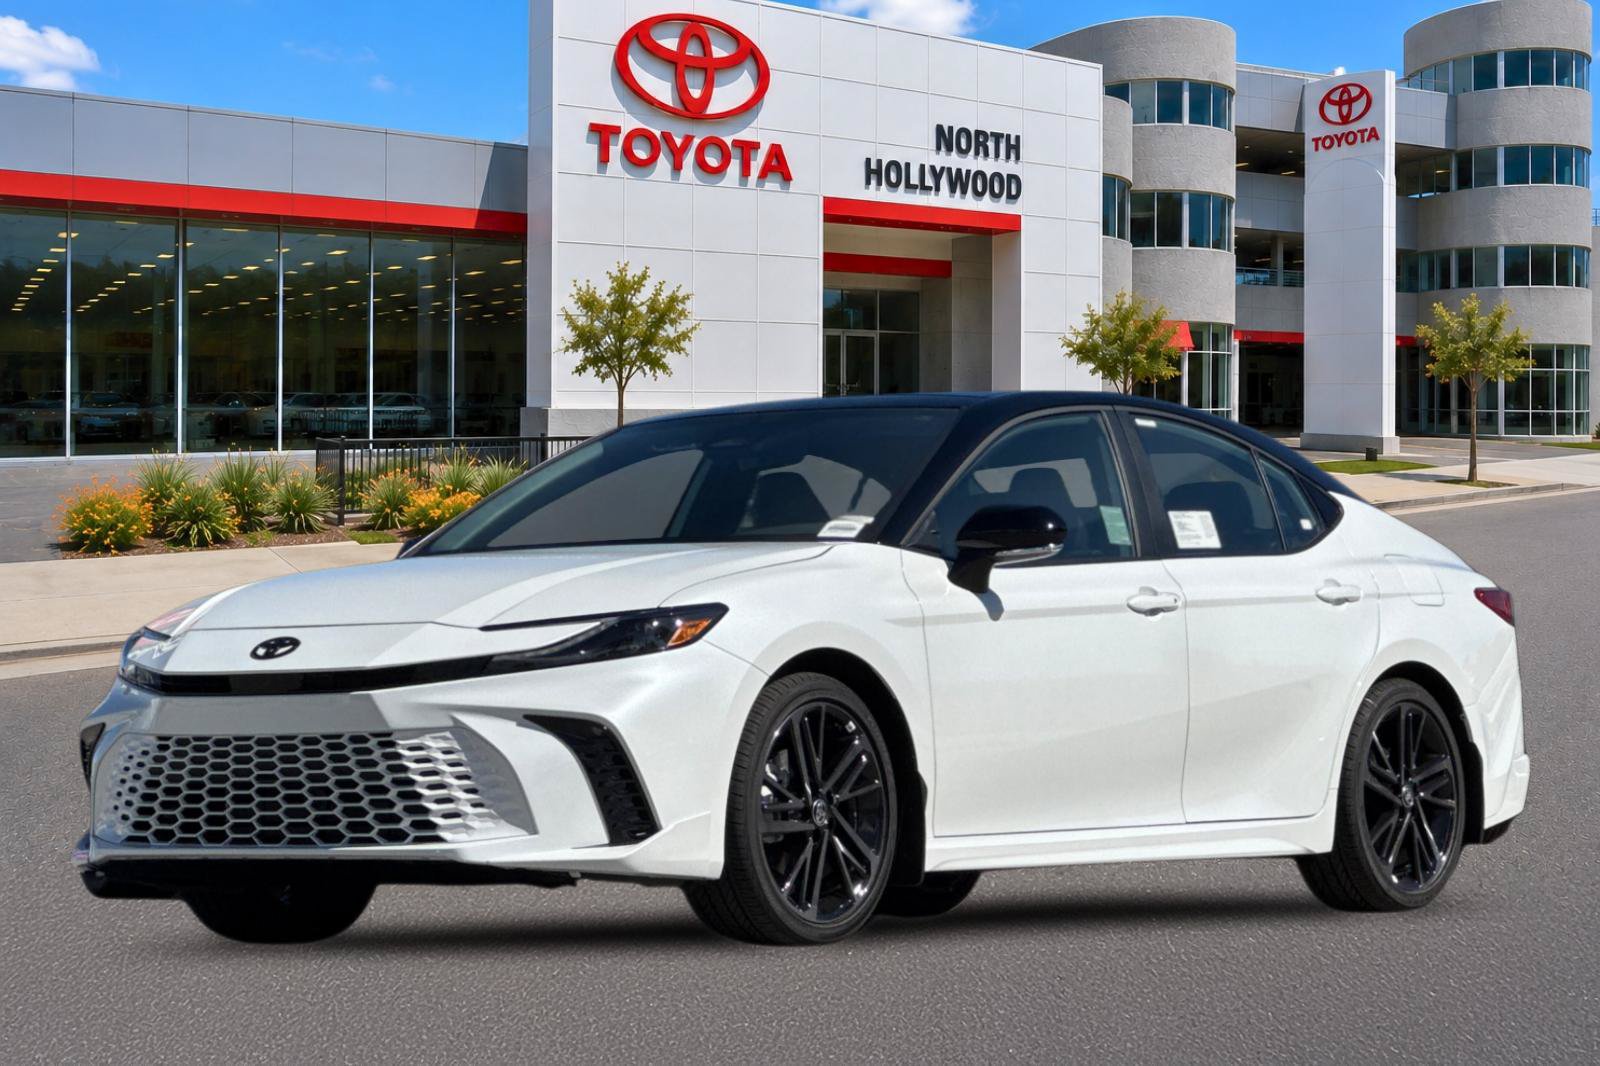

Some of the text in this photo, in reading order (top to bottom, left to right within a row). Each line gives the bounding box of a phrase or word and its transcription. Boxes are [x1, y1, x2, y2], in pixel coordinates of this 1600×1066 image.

[589, 122, 793, 182] TOYOTA
[935, 123, 1021, 162] NORTH
[1311, 126, 1380, 152] TOYOTA
[865, 157, 1022, 201] HOLLYWOOD
